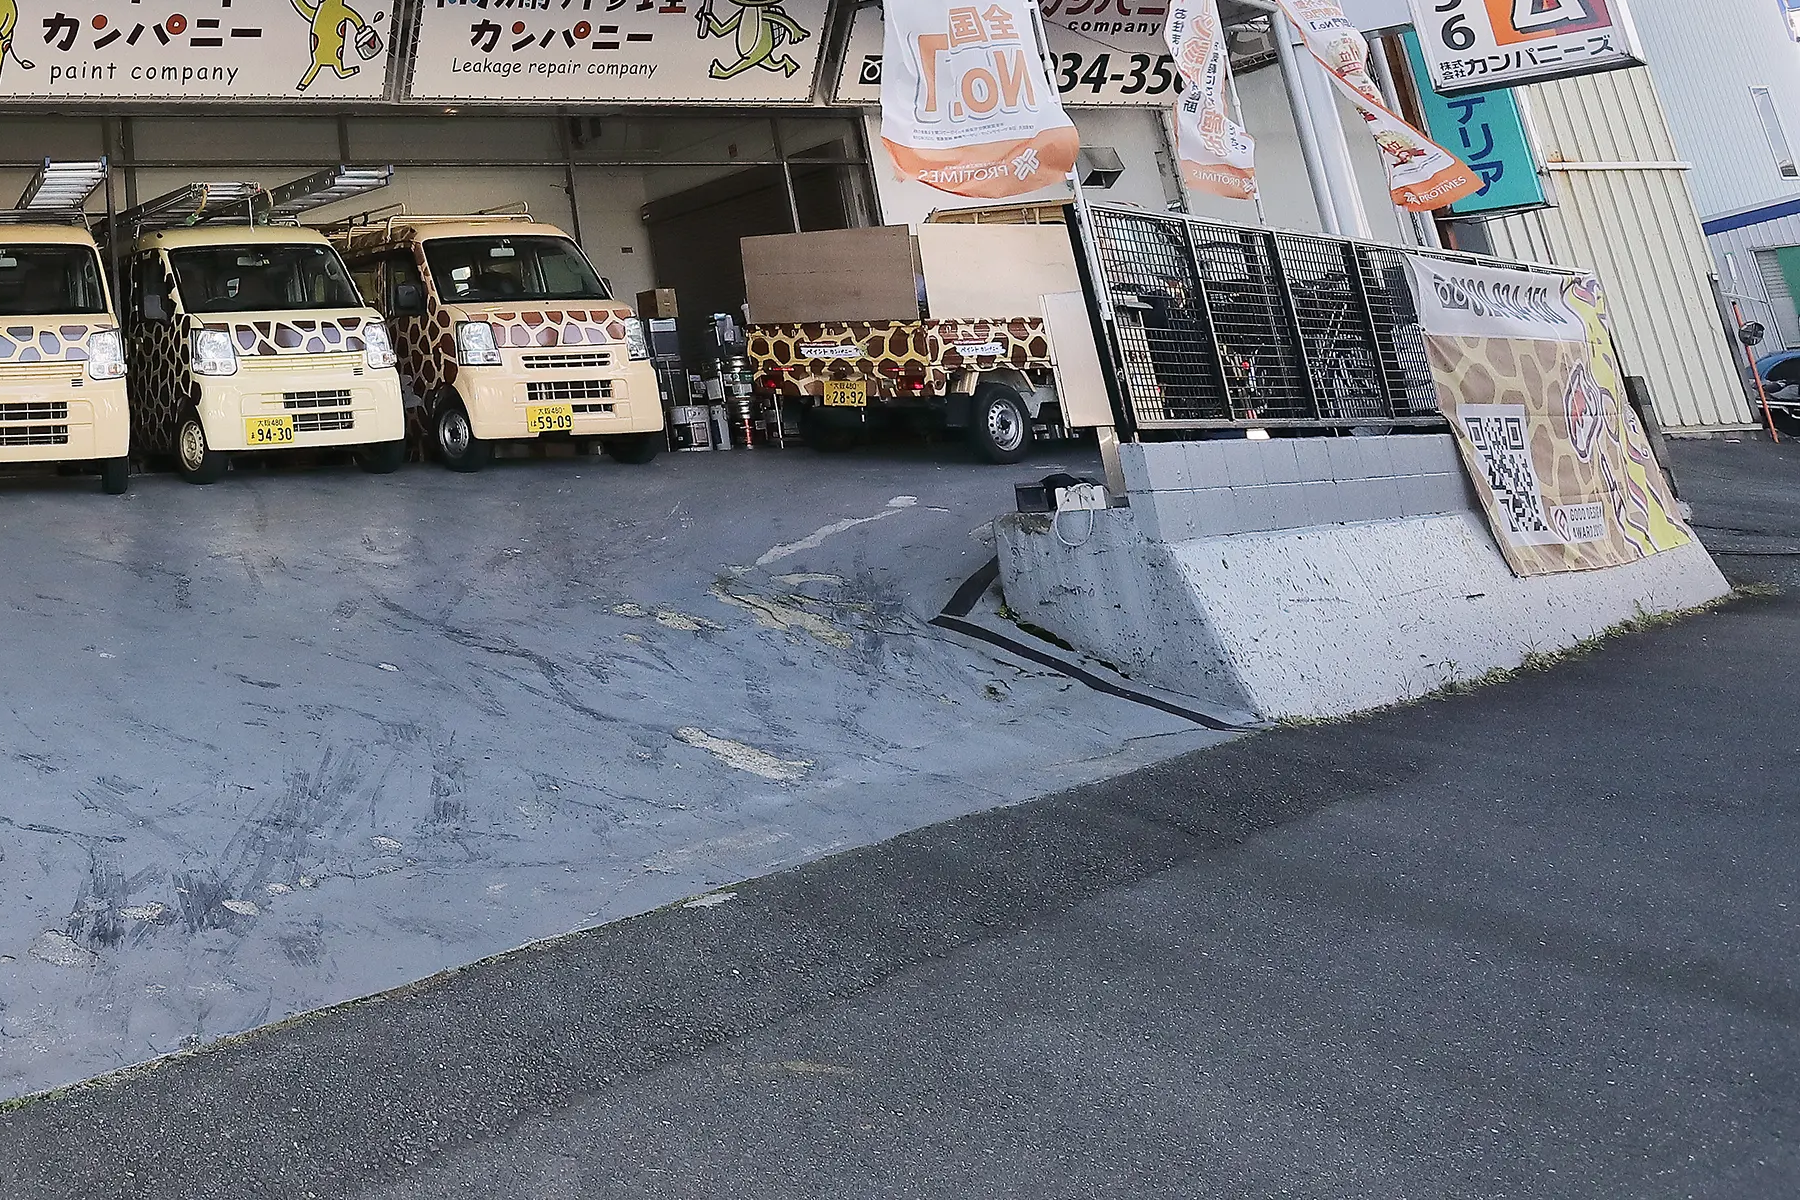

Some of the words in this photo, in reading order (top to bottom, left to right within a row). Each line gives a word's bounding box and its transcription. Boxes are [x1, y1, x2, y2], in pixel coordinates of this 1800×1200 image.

[42, 11, 263, 52] カンパニー
[469, 19, 654, 52] カンパニー
[1067, 20, 1161, 36] company
[1466, 33, 1616, 75] カンパニーズ
[49, 61, 117, 85] paint
[130, 64, 240, 86] company
[452, 57, 522, 76] Leakage
[528, 59, 581, 76] repair
[587, 62, 658, 80] company
[1447, 96, 1504, 197] テリア
[257, 427, 293, 442] 94-30
[537, 414, 572, 430] 59-09
